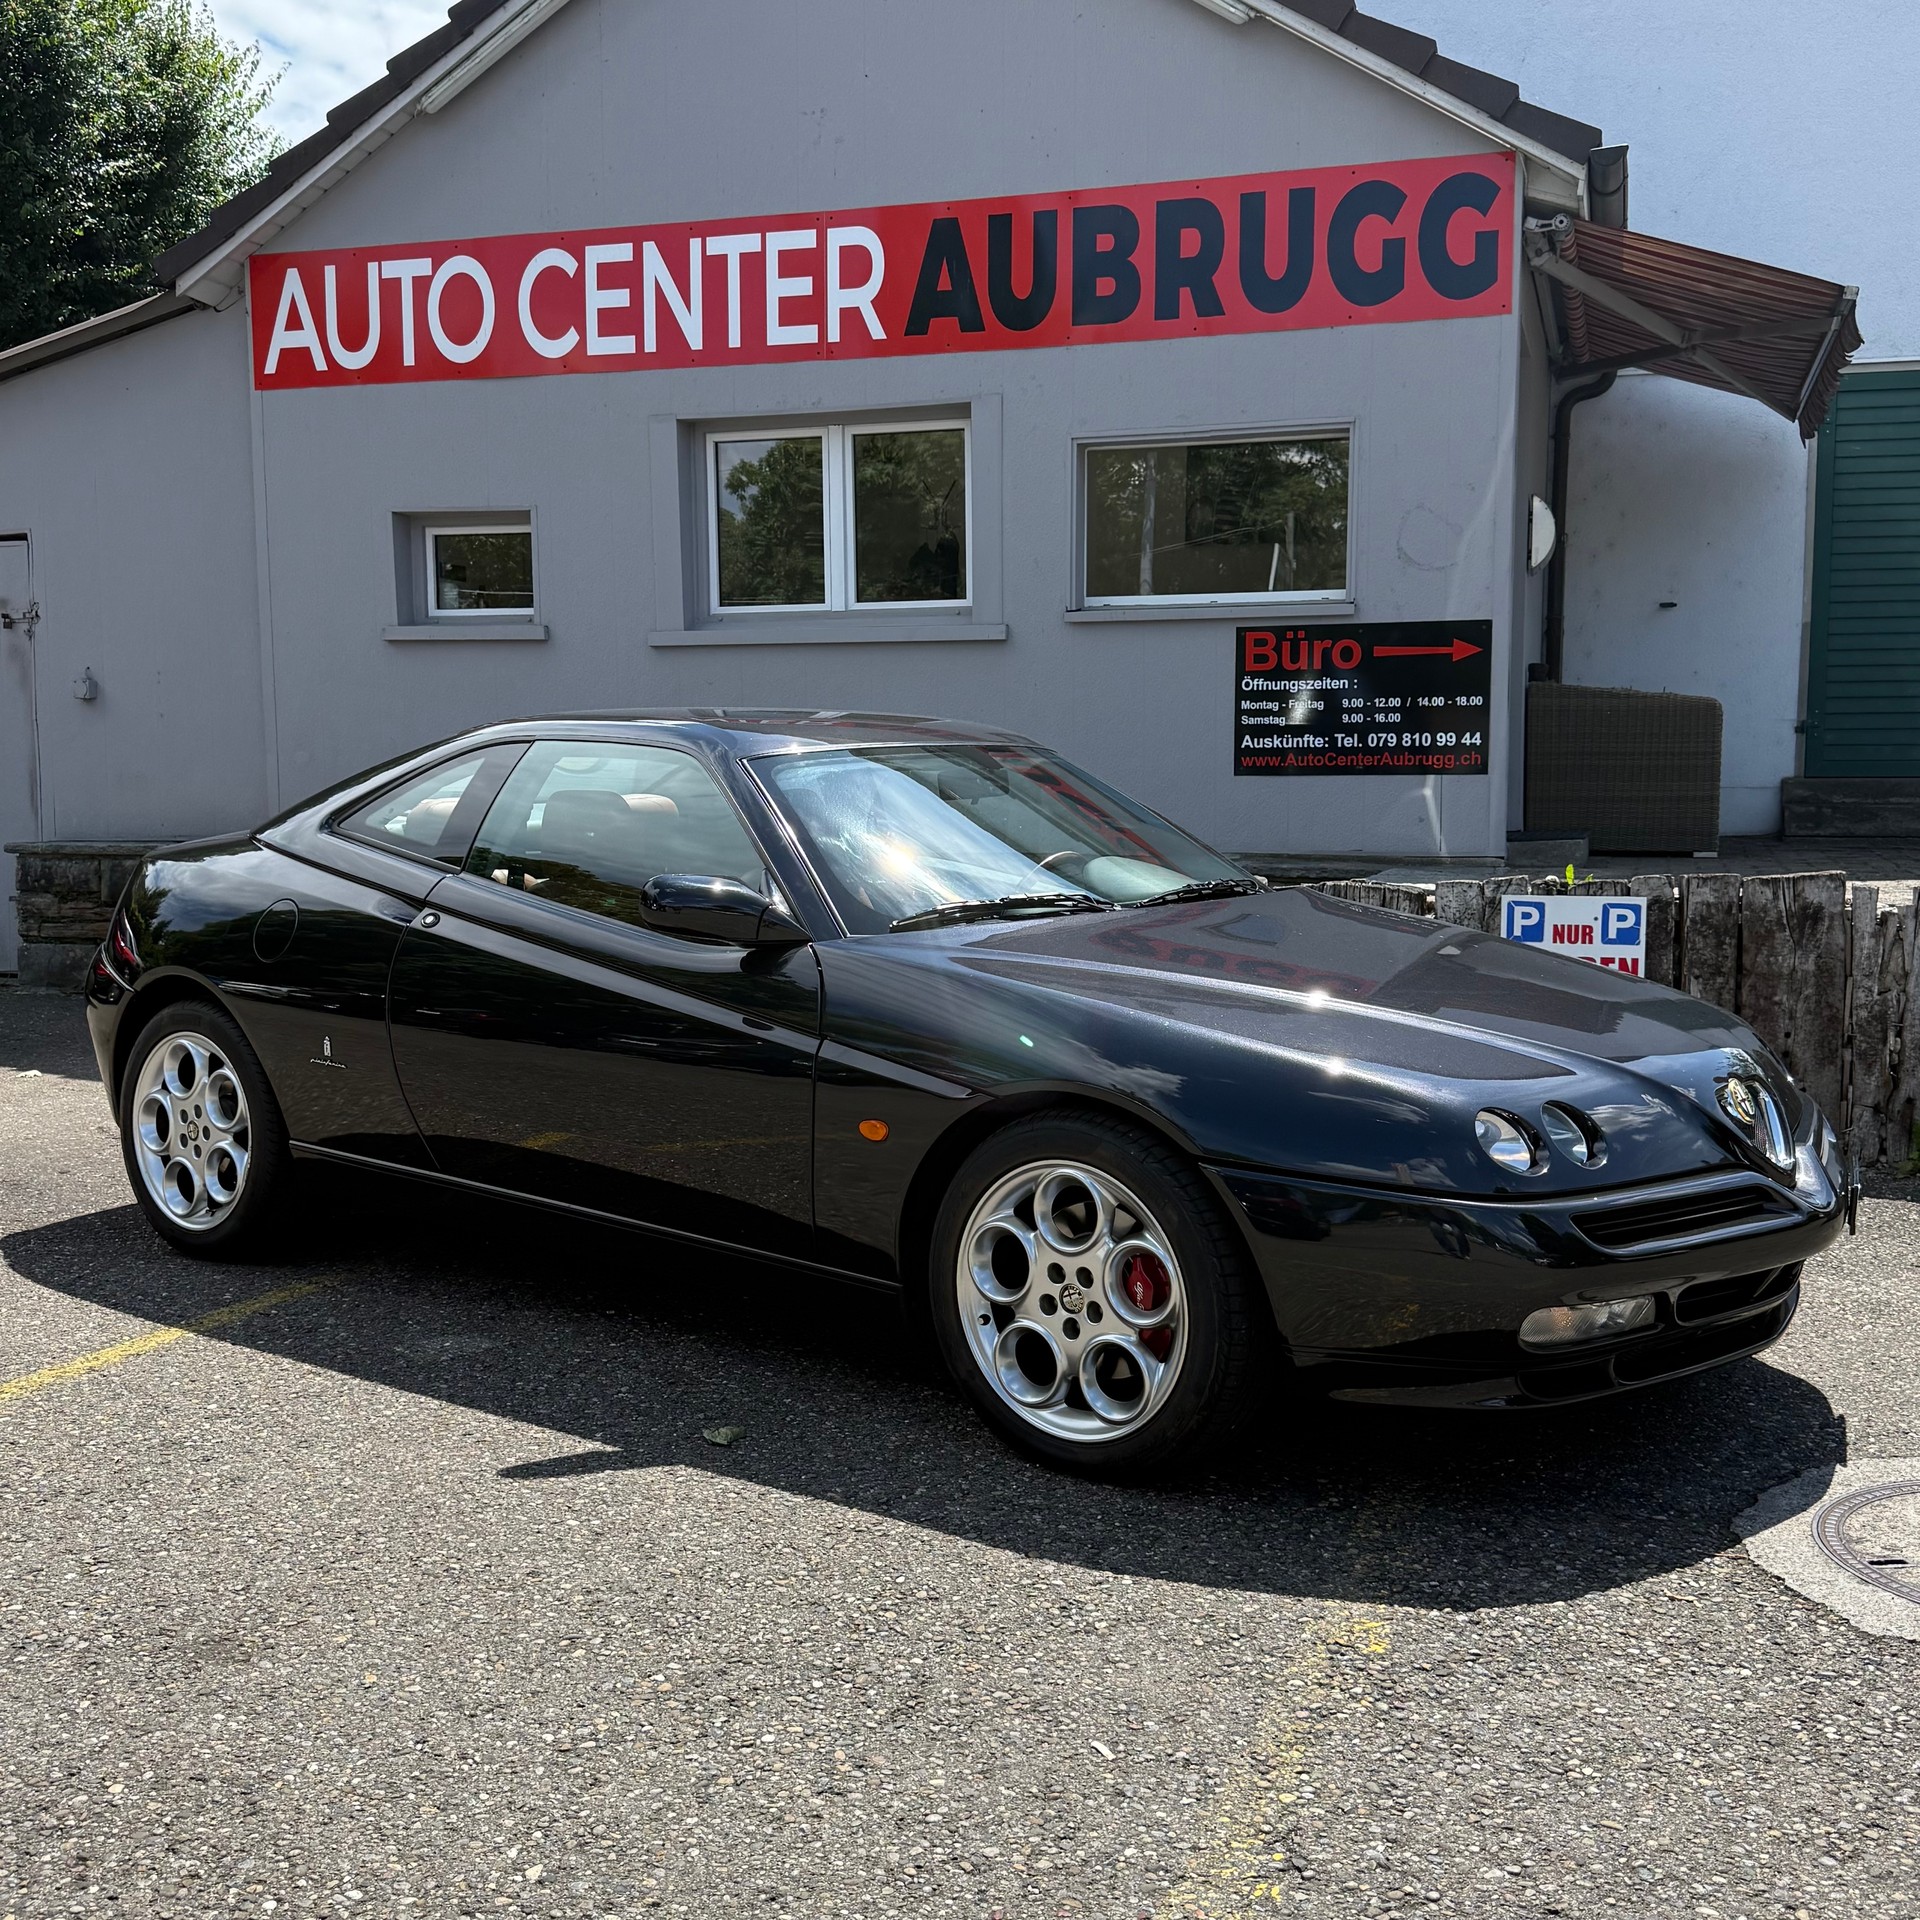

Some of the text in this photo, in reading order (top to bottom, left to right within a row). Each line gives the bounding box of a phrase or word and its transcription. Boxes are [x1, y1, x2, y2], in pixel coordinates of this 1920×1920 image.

[263, 172, 1501, 375] AUTO CENTER AUBRUGG
[1245, 630, 1362, 671] Büro
[1241, 676, 1349, 693] Öffnungszeiten
[1241, 700, 1279, 711] Montag
[1288, 699, 1324, 711] Freitag
[1342, 698, 1364, 708] 9.00
[1374, 697, 1401, 707] 12.00
[1417, 696, 1444, 707] 14.00
[1455, 696, 1483, 706] 18.00
[1241, 715, 1286, 726] Samstag
[1342, 713, 1364, 723] 9.00
[1374, 712, 1401, 723] 16.00
[1241, 731, 1482, 748] Auskünfte: Tel. 079 810 99 44
[1241, 751, 1481, 769] www.AutoCenterAubrugg.ch
[1552, 924, 1594, 945] NUR
